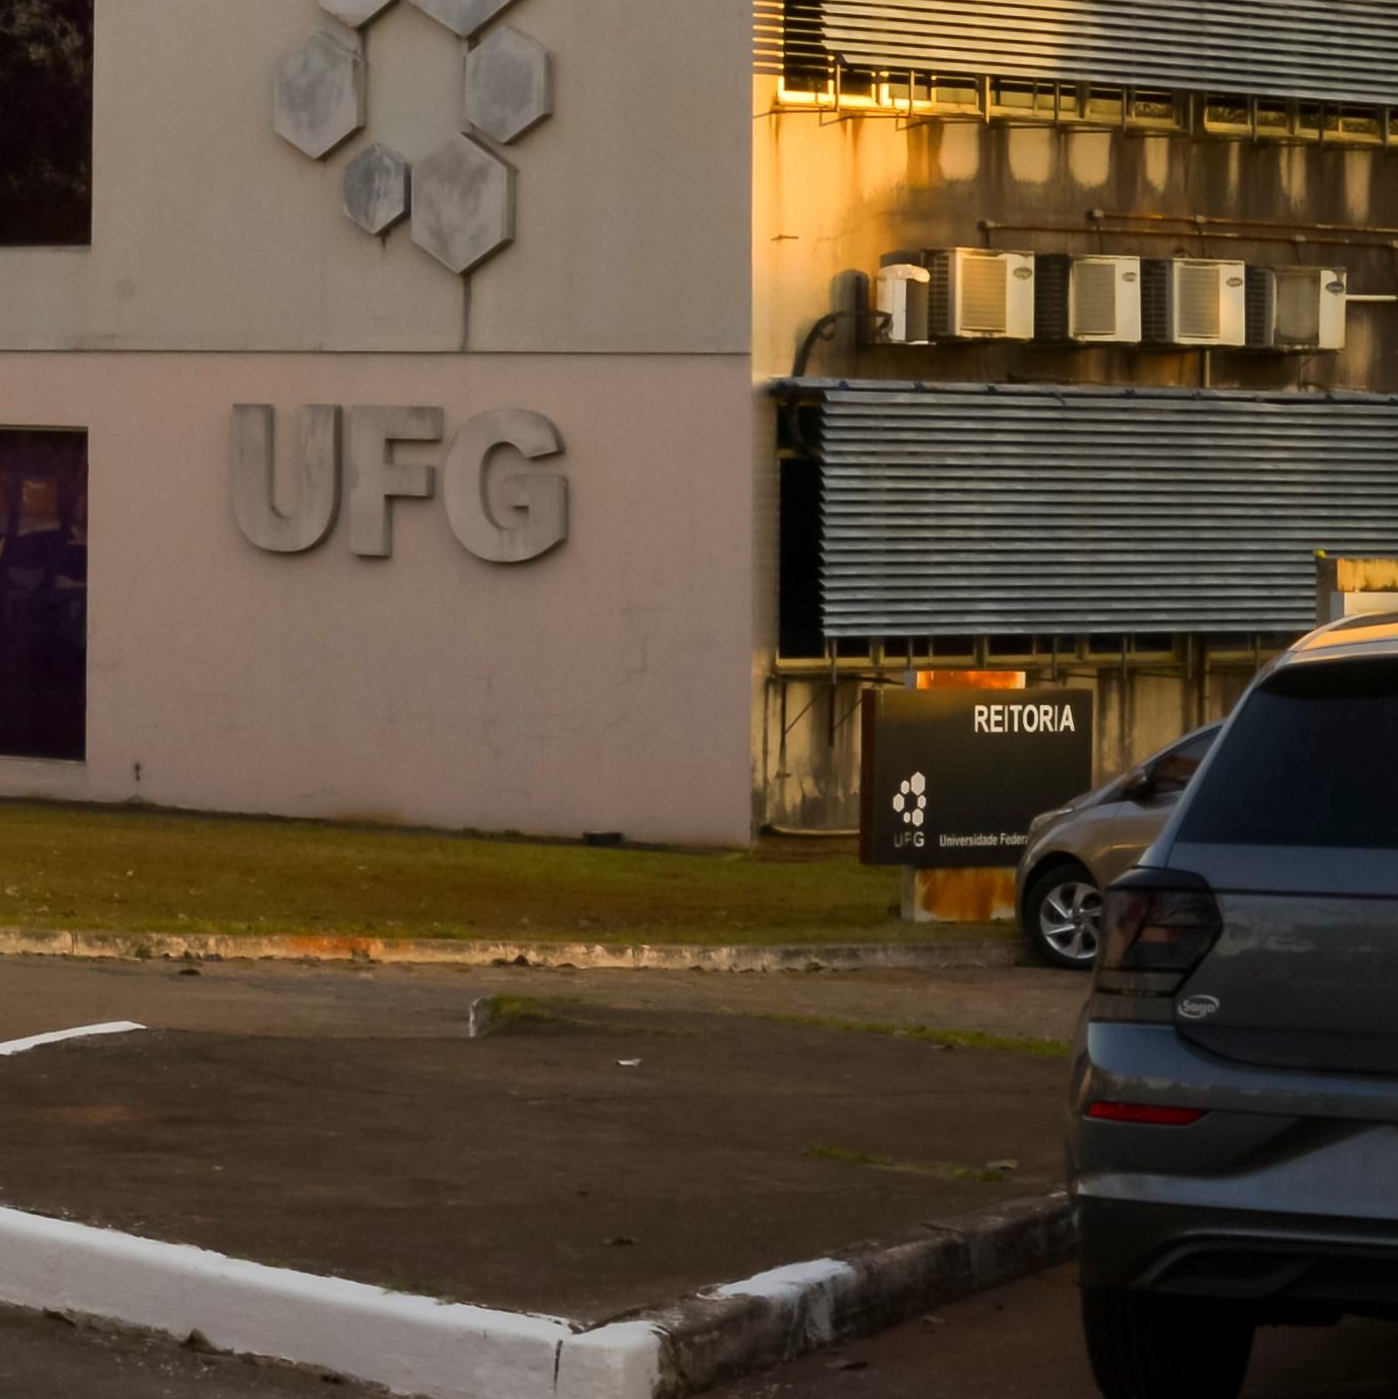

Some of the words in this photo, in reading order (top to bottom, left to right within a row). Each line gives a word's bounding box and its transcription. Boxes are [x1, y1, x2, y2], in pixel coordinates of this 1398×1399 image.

[231, 403, 571, 564] UFG
[974, 704, 1076, 733] REITORIA
[893, 831, 925, 848] UFG
[939, 834, 998, 847] Universidade
